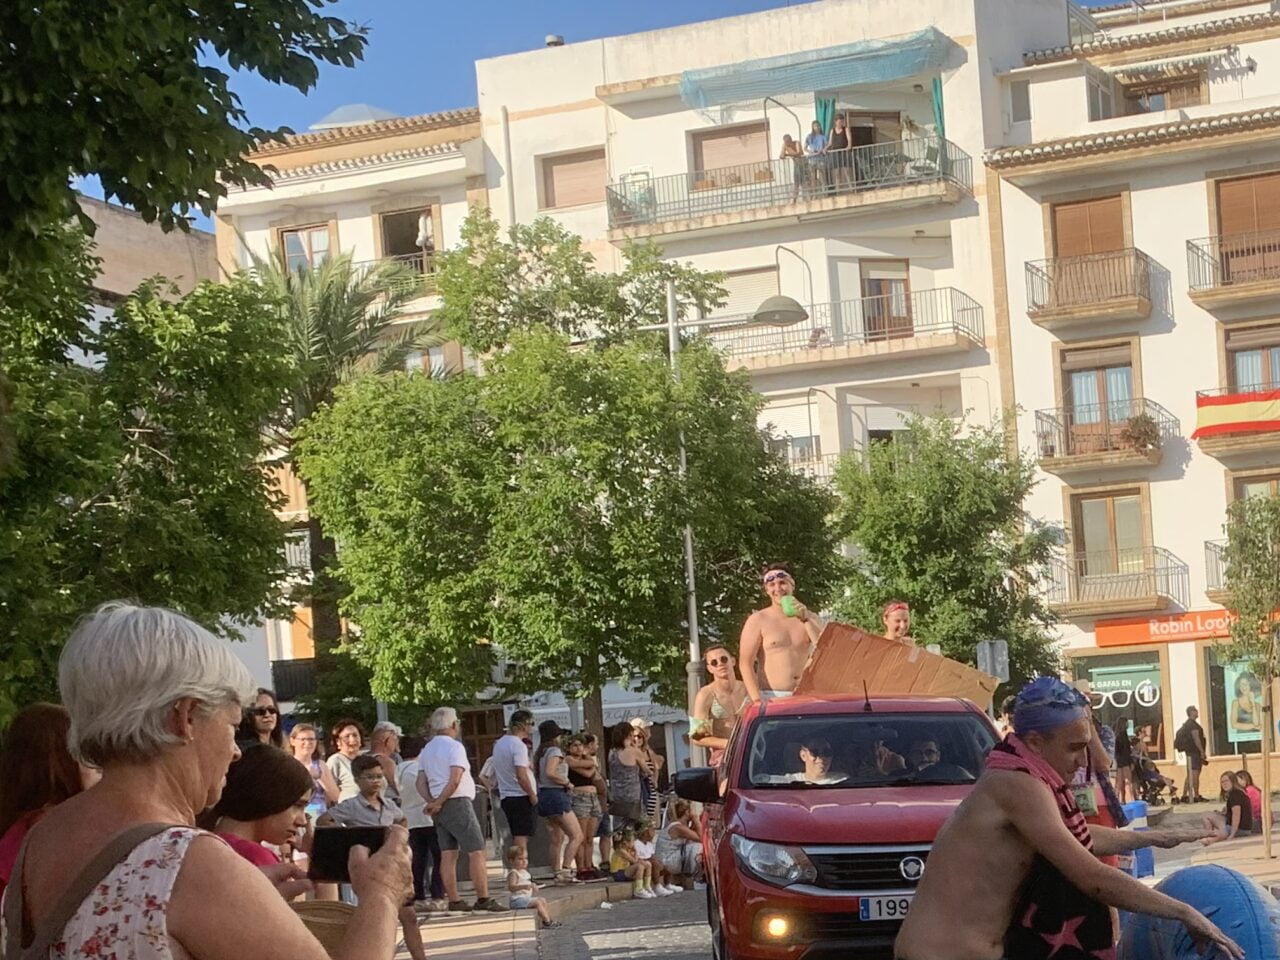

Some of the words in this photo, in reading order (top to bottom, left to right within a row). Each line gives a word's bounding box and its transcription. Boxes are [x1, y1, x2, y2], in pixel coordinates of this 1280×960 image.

[1149, 617, 1193, 636] Robin
[1096, 680, 1120, 688] GAFAS
[876, 898, 909, 917] 199
